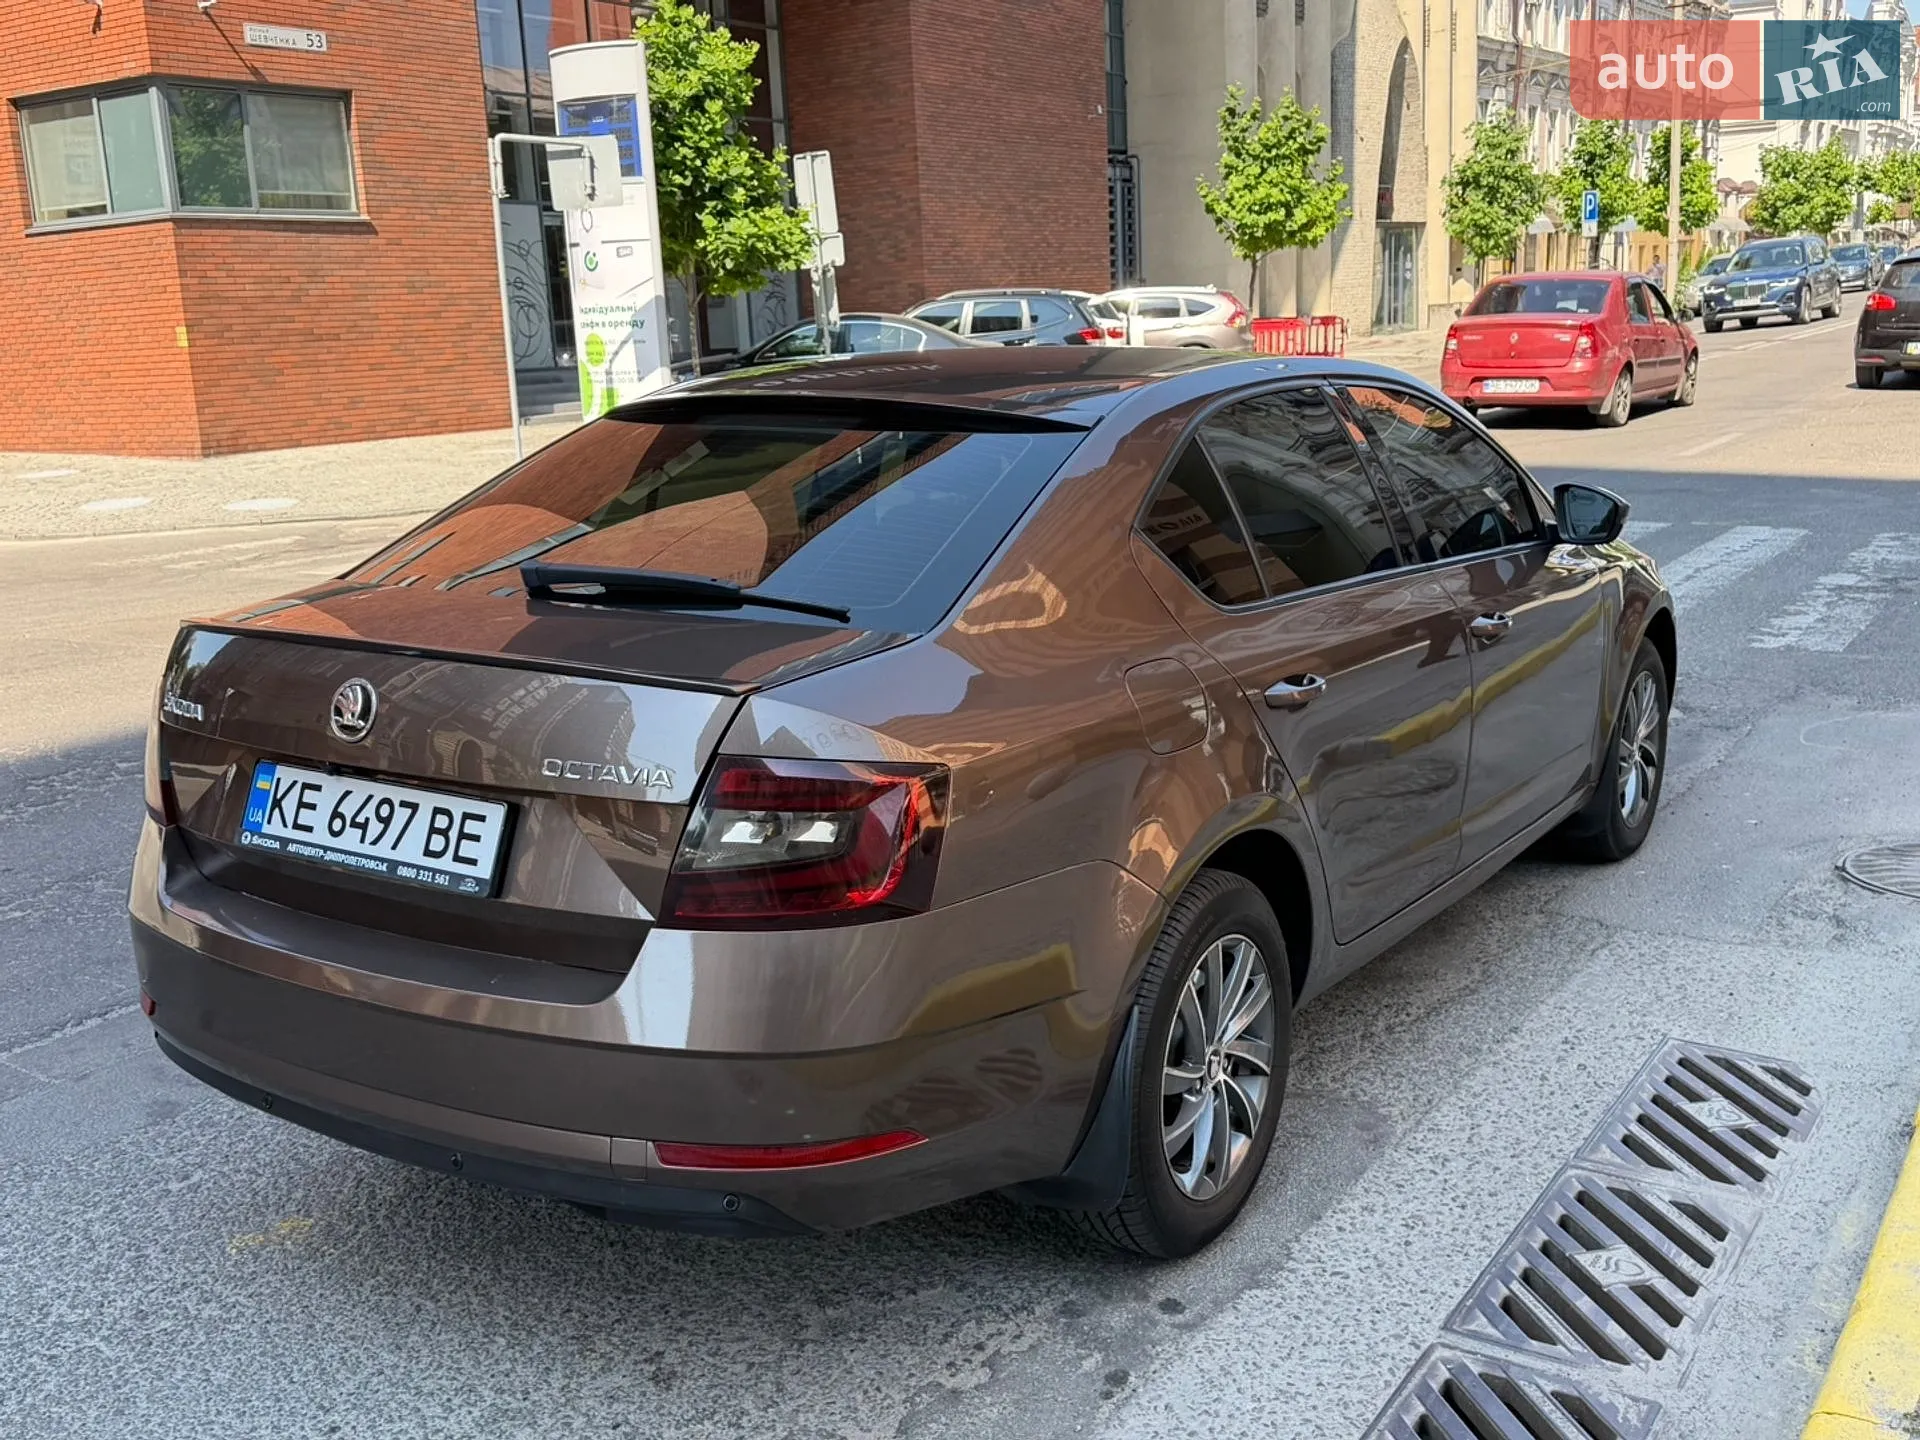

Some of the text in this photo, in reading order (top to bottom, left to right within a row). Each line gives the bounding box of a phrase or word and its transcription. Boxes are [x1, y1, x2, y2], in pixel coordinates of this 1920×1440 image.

[305, 33, 323, 49] 53
[1586, 194, 1595, 218] P
[608, 319, 645, 330] оренду
[541, 758, 673, 789] OCTAVIA
[248, 807, 263, 824] UA
[266, 777, 488, 867] KE 6497 BE
[396, 865, 450, 885] 0800 331 561
